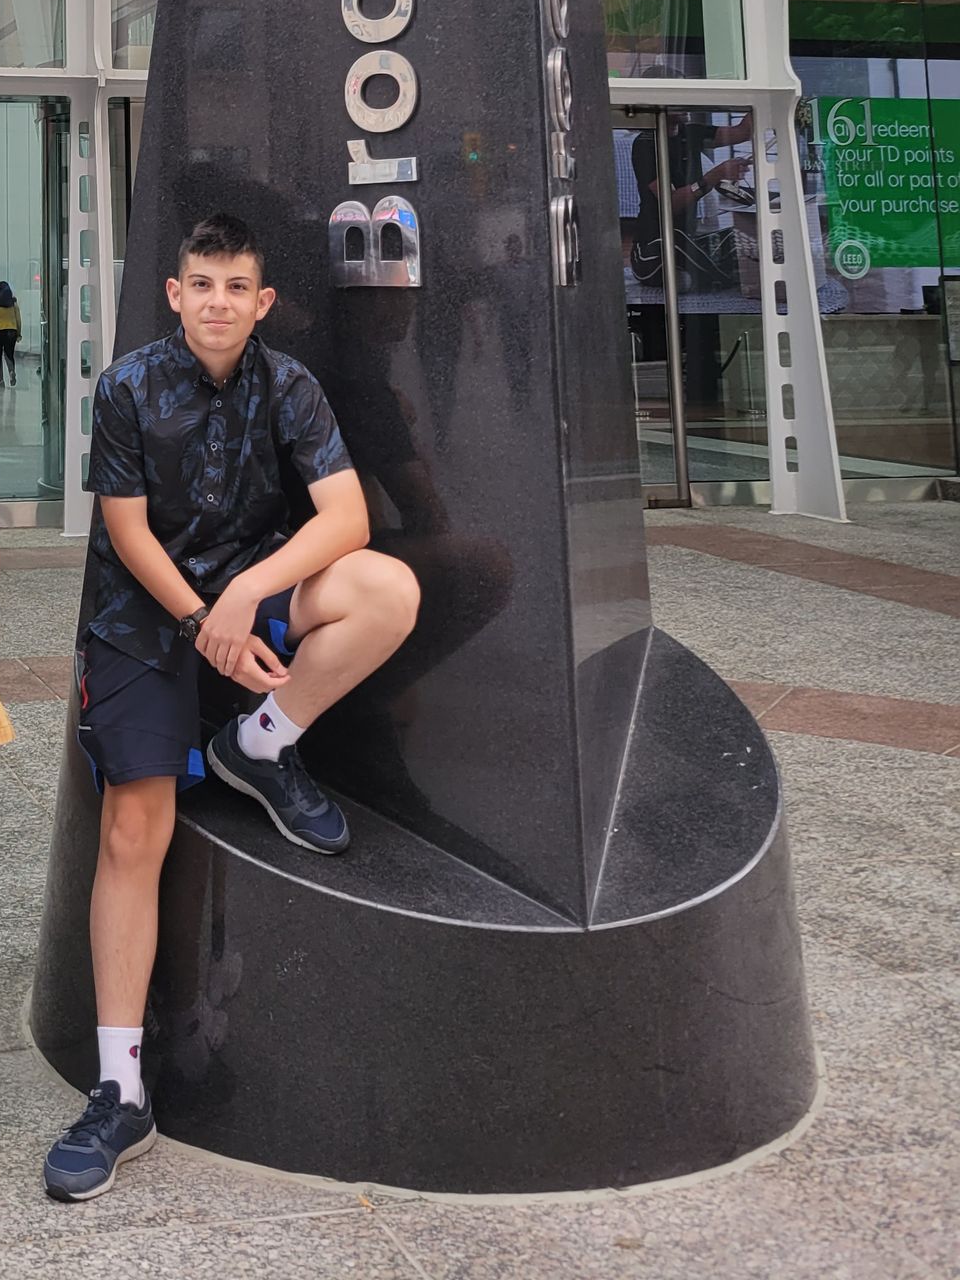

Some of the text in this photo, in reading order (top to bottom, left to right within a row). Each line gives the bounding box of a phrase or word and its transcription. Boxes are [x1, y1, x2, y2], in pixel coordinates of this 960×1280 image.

[806, 98, 879, 146] 161
[835, 145, 955, 166] your TD points
[837, 170, 861, 187] for
[864, 170, 884, 188] all
[888, 174, 906, 188] or
[840, 199, 877, 216] your
